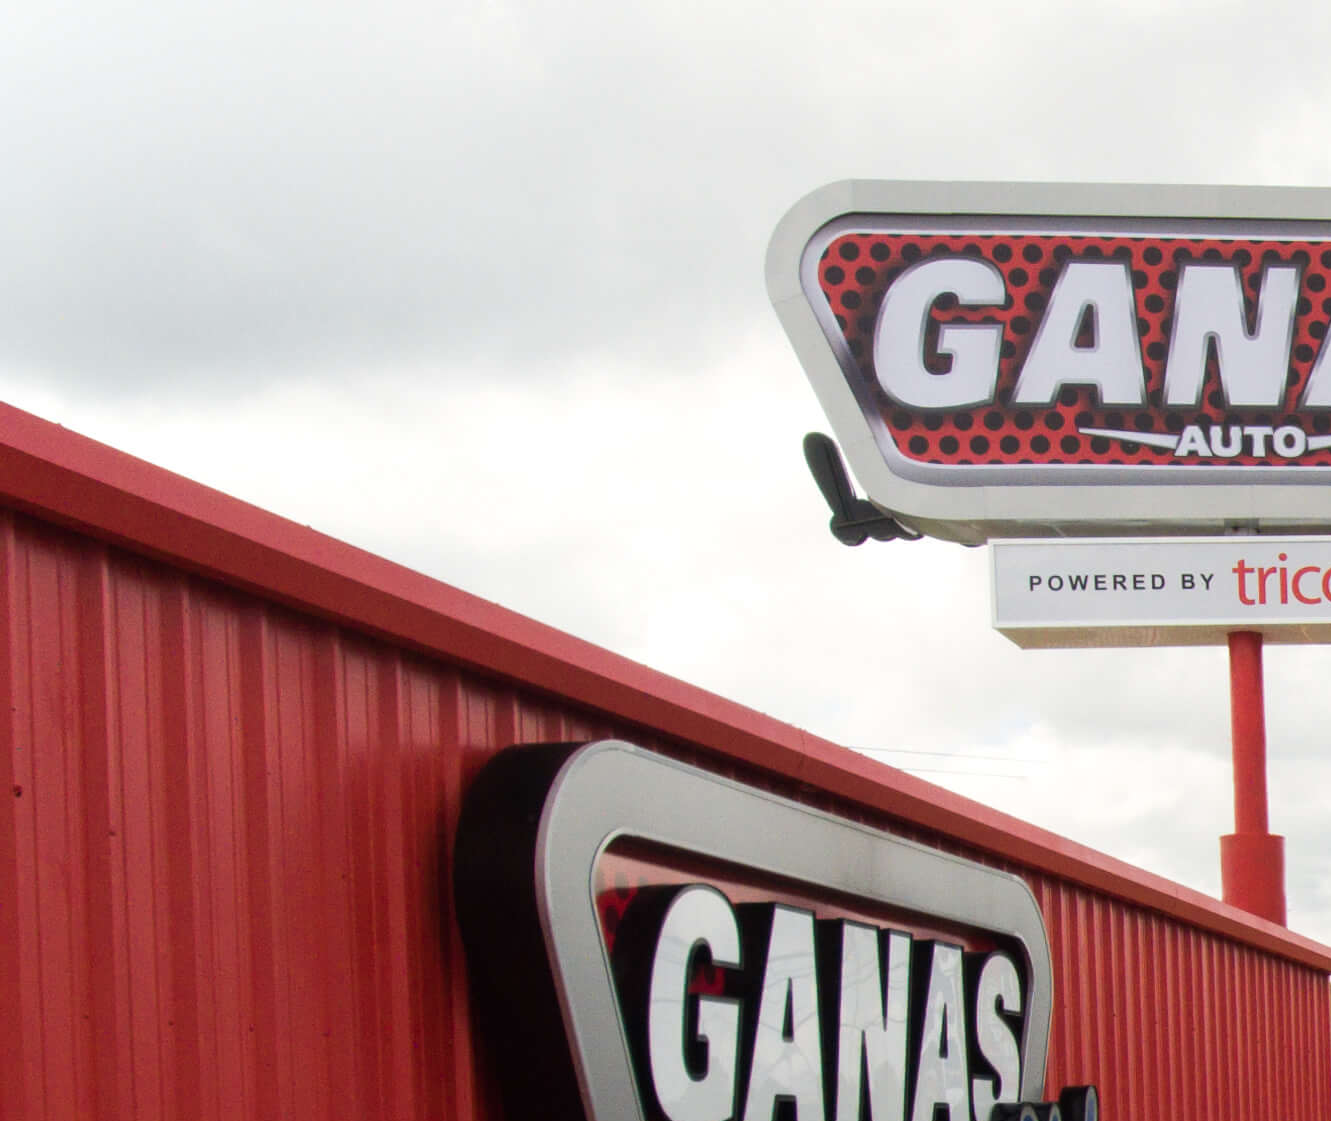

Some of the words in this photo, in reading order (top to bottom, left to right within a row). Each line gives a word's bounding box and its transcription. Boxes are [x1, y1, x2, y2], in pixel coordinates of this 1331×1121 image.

[1175, 425, 1308, 458] AUTO
[1029, 573, 1167, 594] POWERED
[1179, 572, 1215, 592] BY
